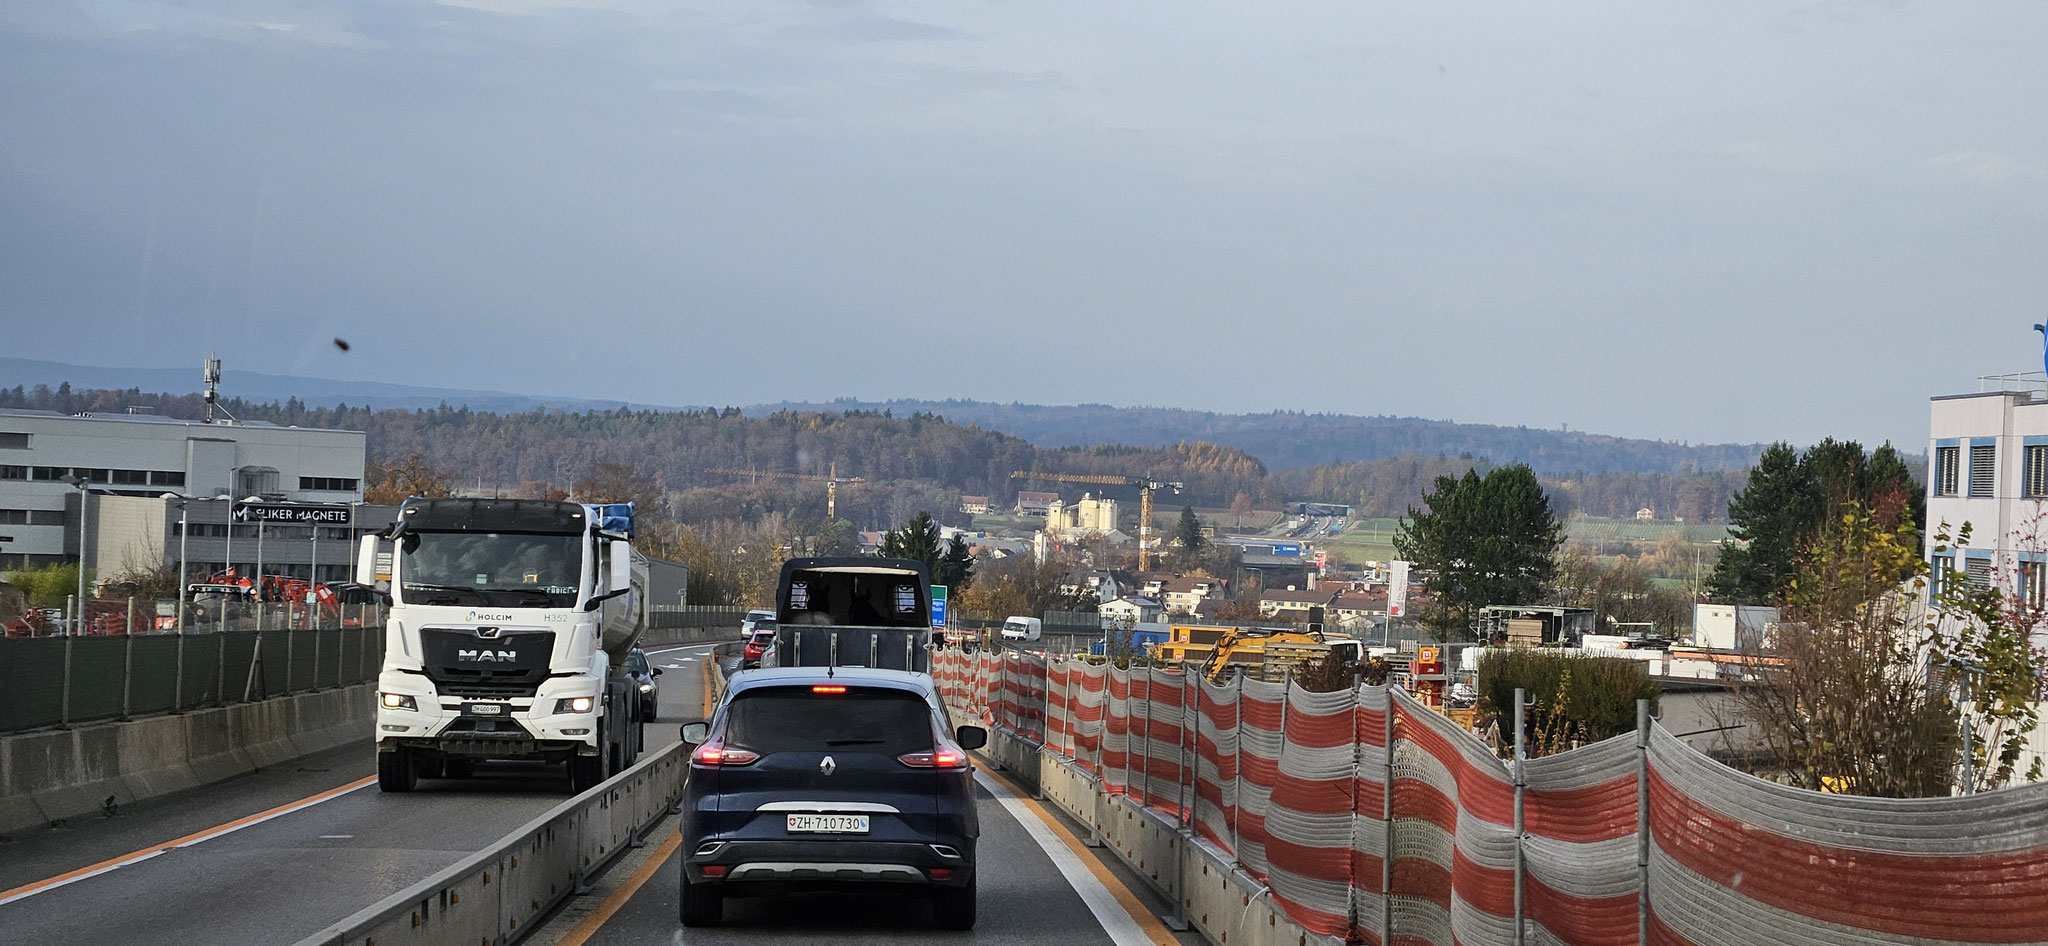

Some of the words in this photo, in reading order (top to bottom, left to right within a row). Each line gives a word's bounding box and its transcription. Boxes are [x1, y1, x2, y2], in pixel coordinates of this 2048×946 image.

[296, 510, 347, 521] MAGNETE
[544, 614, 568, 622] H352
[458, 650, 517, 662] MAN
